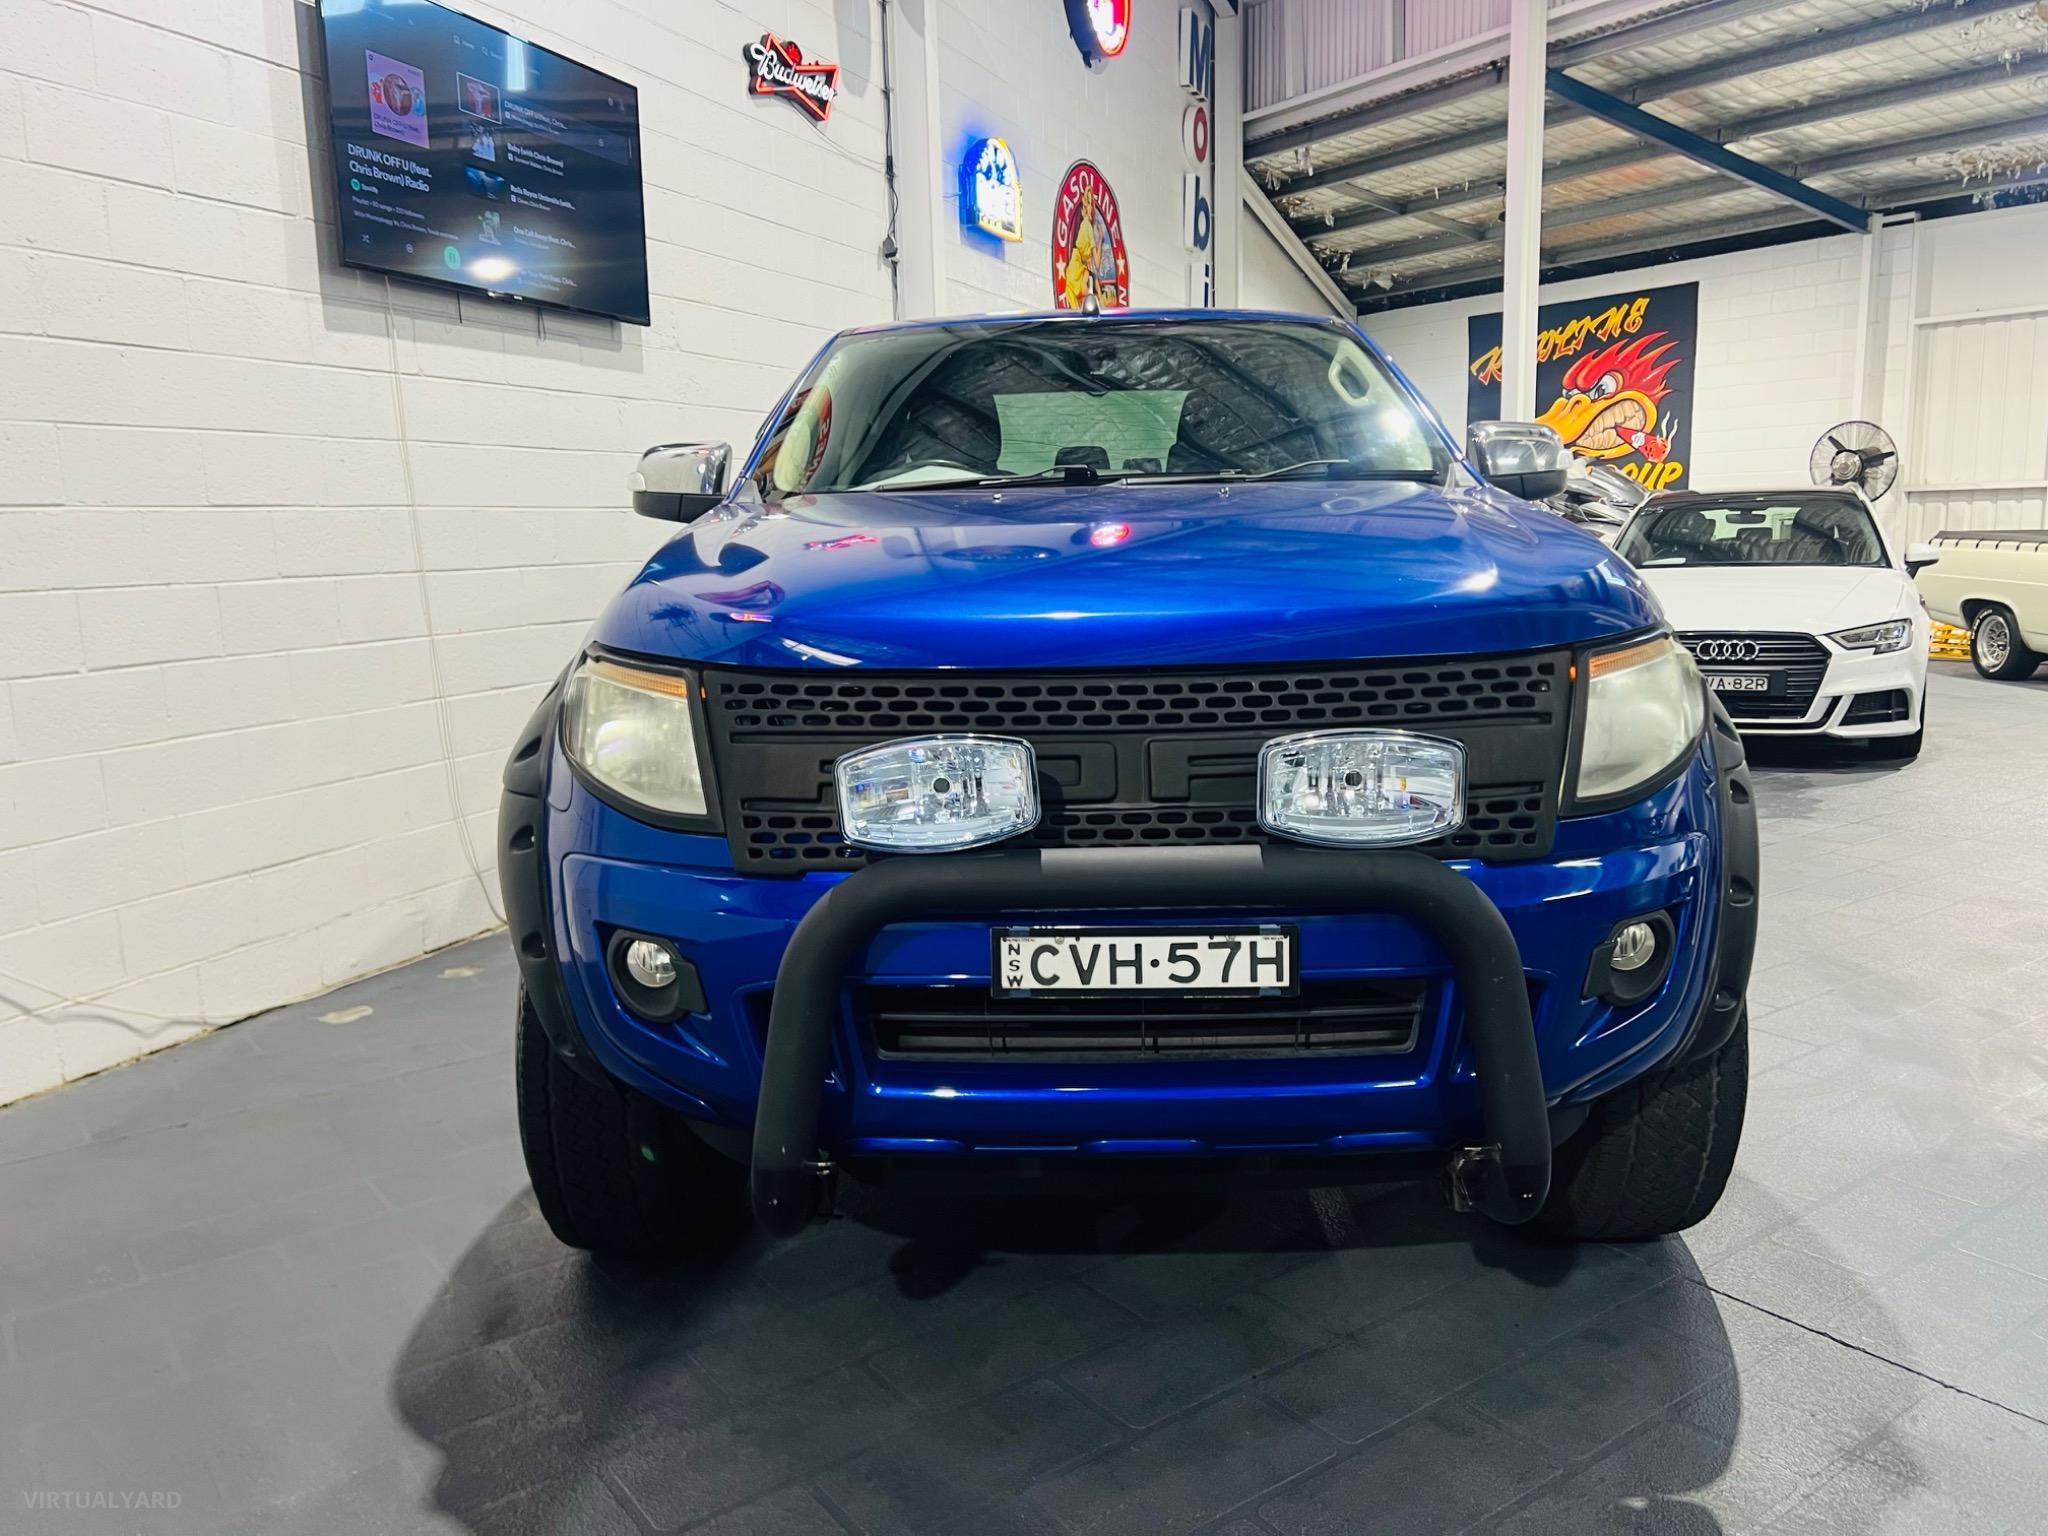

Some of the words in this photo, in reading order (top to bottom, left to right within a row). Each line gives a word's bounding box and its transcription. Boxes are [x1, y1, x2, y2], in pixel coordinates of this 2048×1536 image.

[750, 43, 835, 100] Budweiser
[347, 143, 383, 164] DRUNK
[383, 154, 401, 169] OFF
[401, 160, 409, 171] U
[349, 160, 373, 177] Chris
[373, 166, 405, 187] Brown)
[405, 176, 430, 192] Radio
[1057, 170, 1120, 248] GASOLINE
[1606, 461, 1683, 489] OUP
